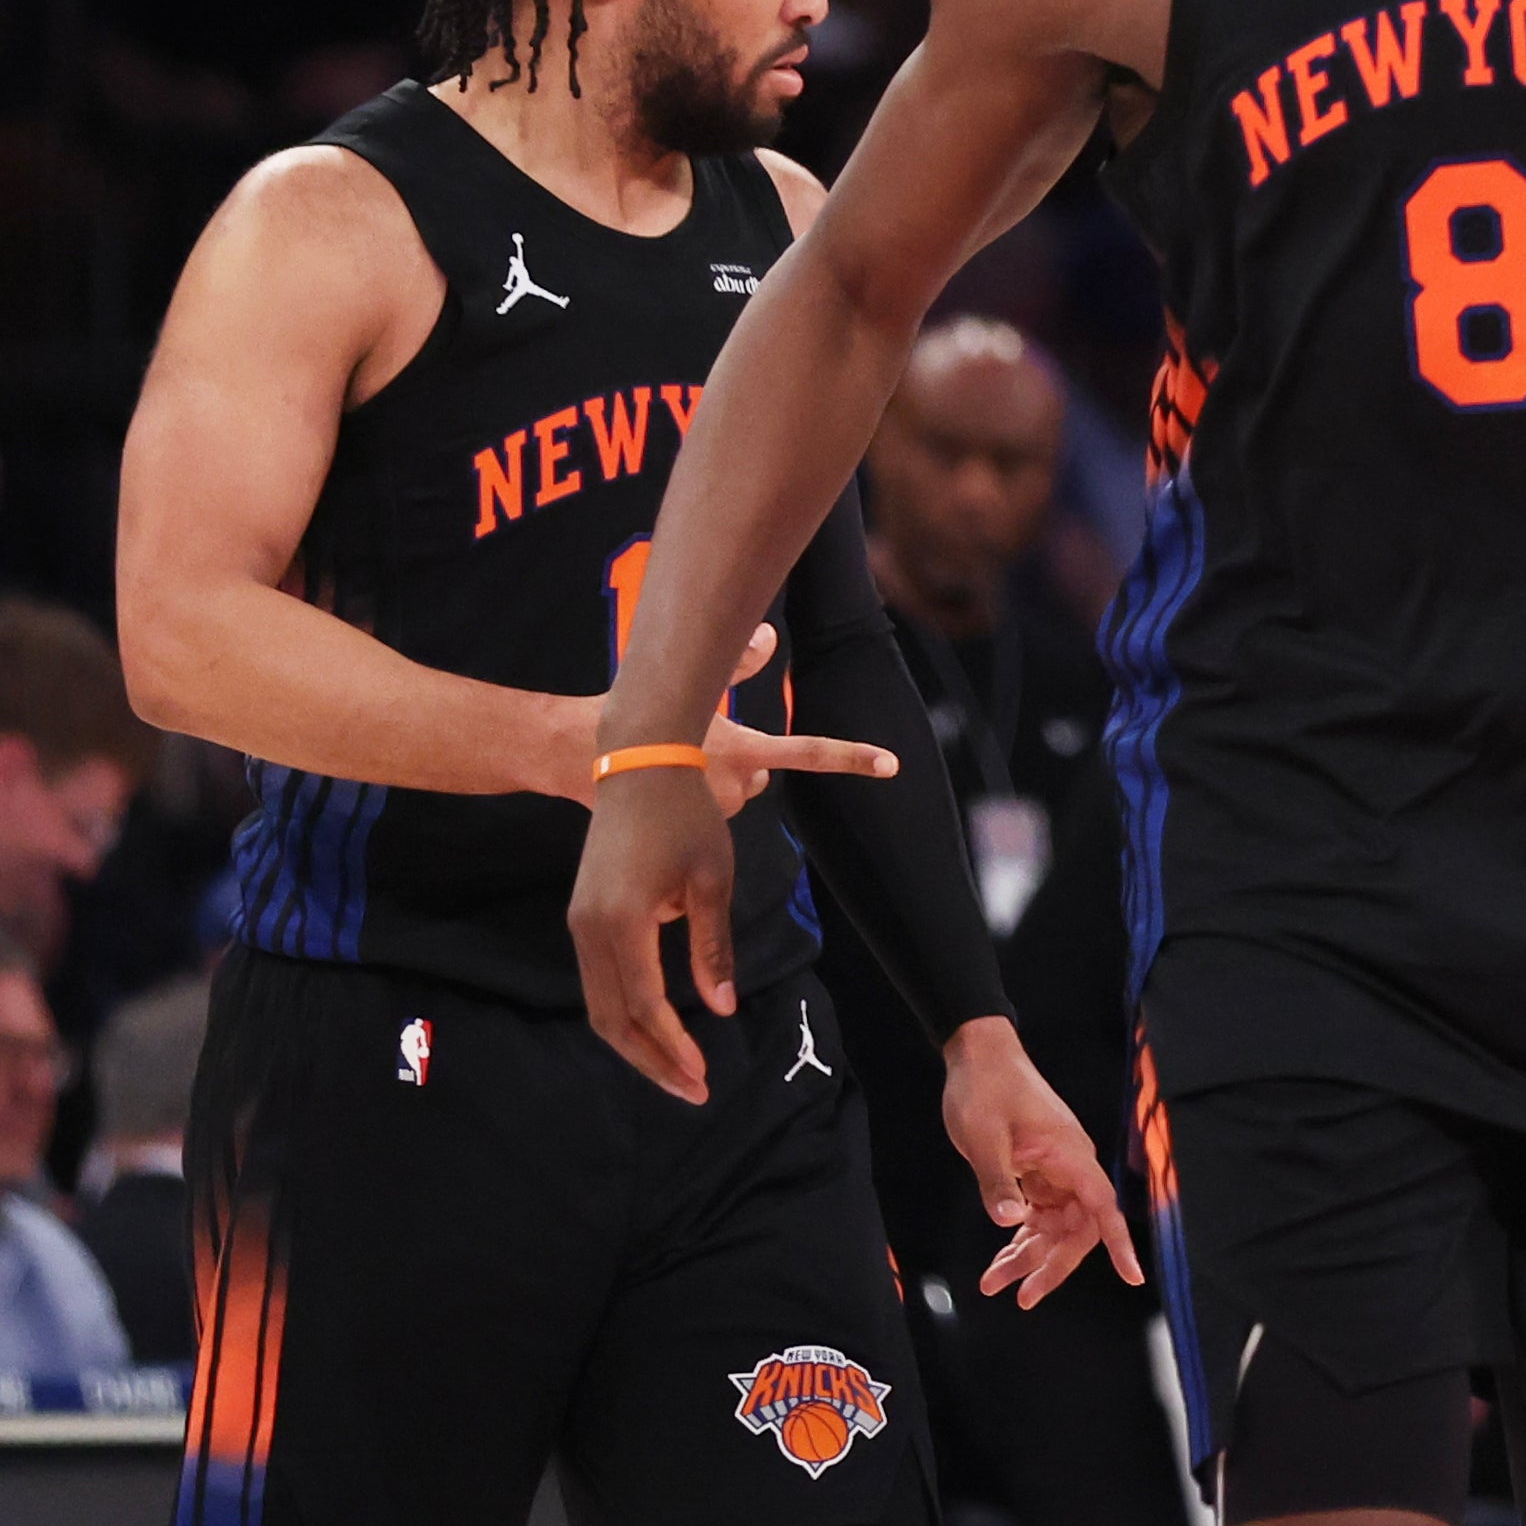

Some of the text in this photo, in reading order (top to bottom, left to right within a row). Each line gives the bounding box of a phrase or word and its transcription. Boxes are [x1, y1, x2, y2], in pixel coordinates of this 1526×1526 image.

[713, 273, 746, 294] abu
[472, 385, 652, 540] NEW
[786, 1348, 845, 1365] NEW YORK
[742, 1360, 883, 1424] KNICKS
